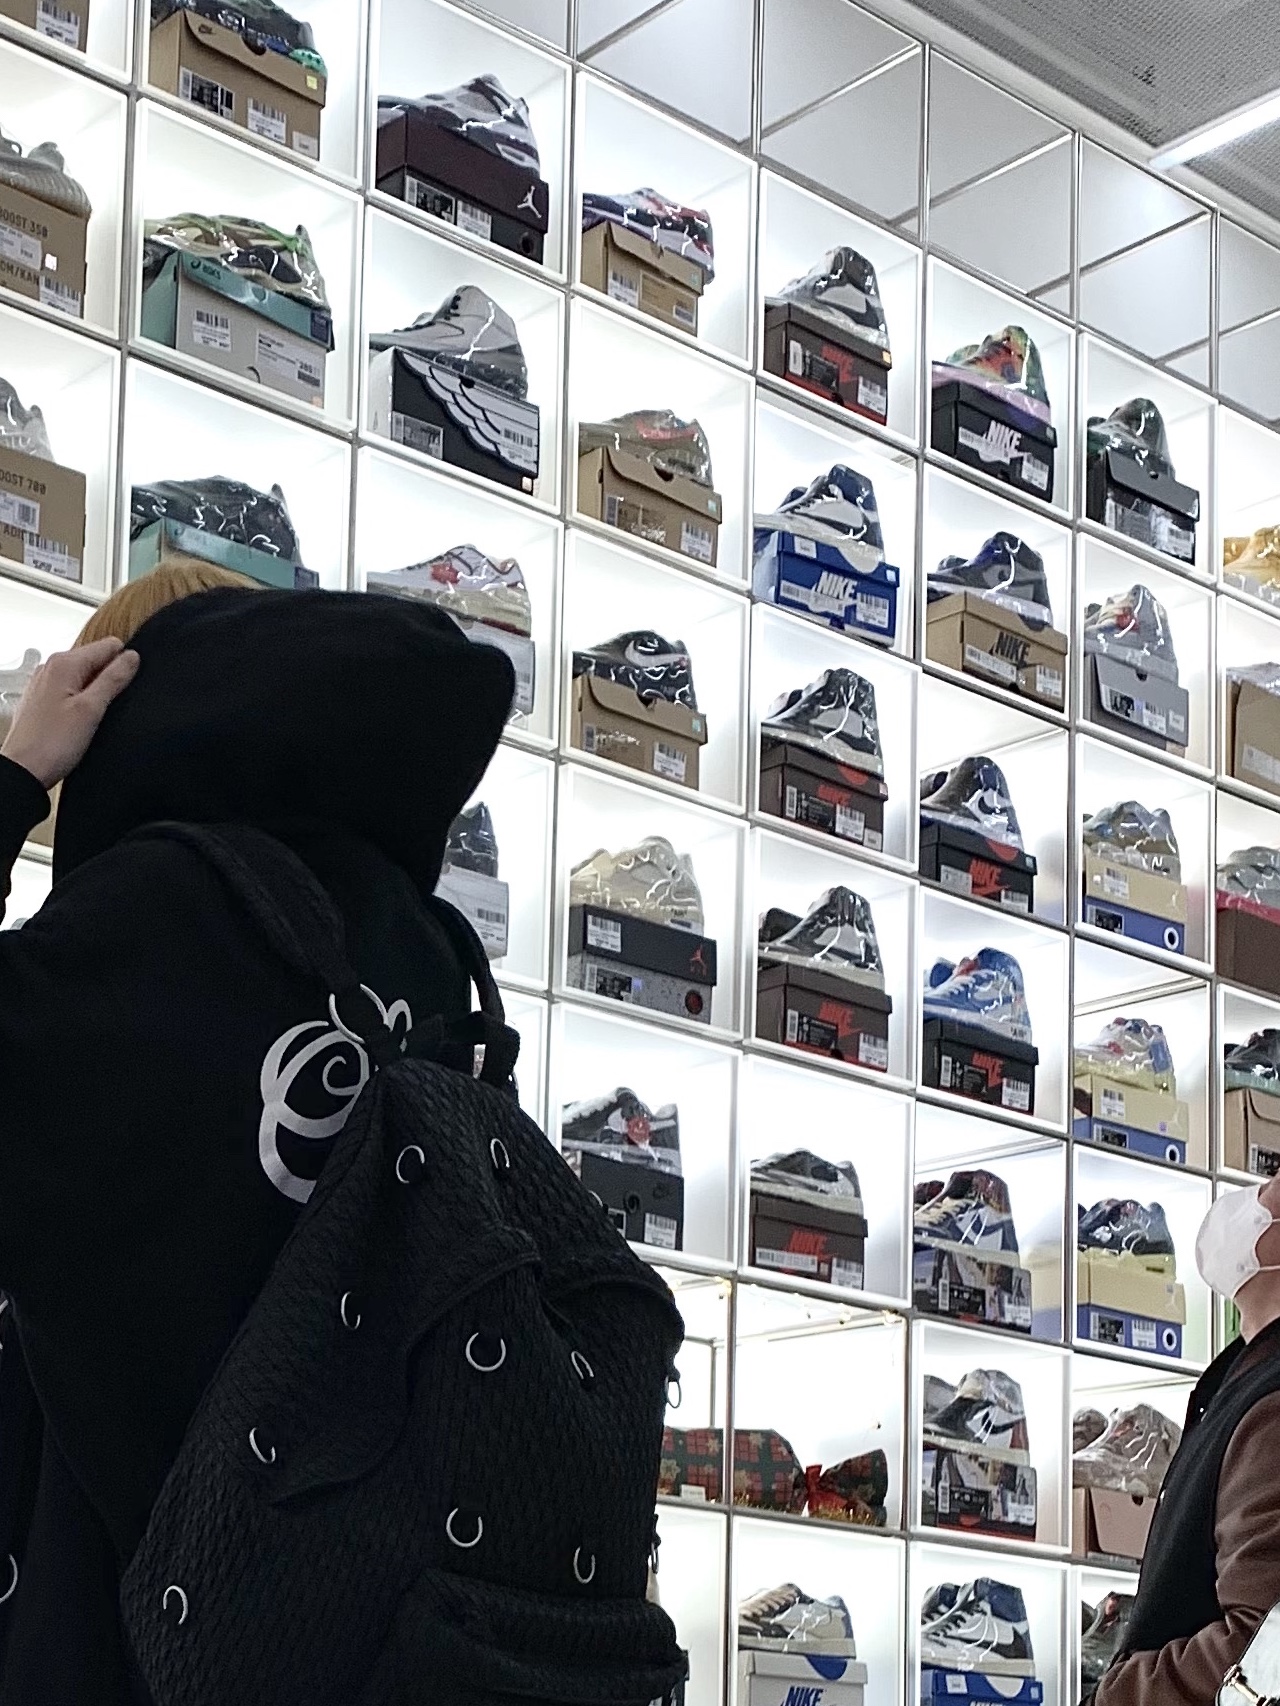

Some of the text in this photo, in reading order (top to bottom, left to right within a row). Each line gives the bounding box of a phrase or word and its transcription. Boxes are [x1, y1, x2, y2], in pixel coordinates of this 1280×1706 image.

[30, 218, 48, 238] 350
[986, 420, 1022, 450] NIKE
[28, 478, 47, 495] 700
[818, 570, 858, 600] NIKE
[995, 630, 1031, 662] NIKE
